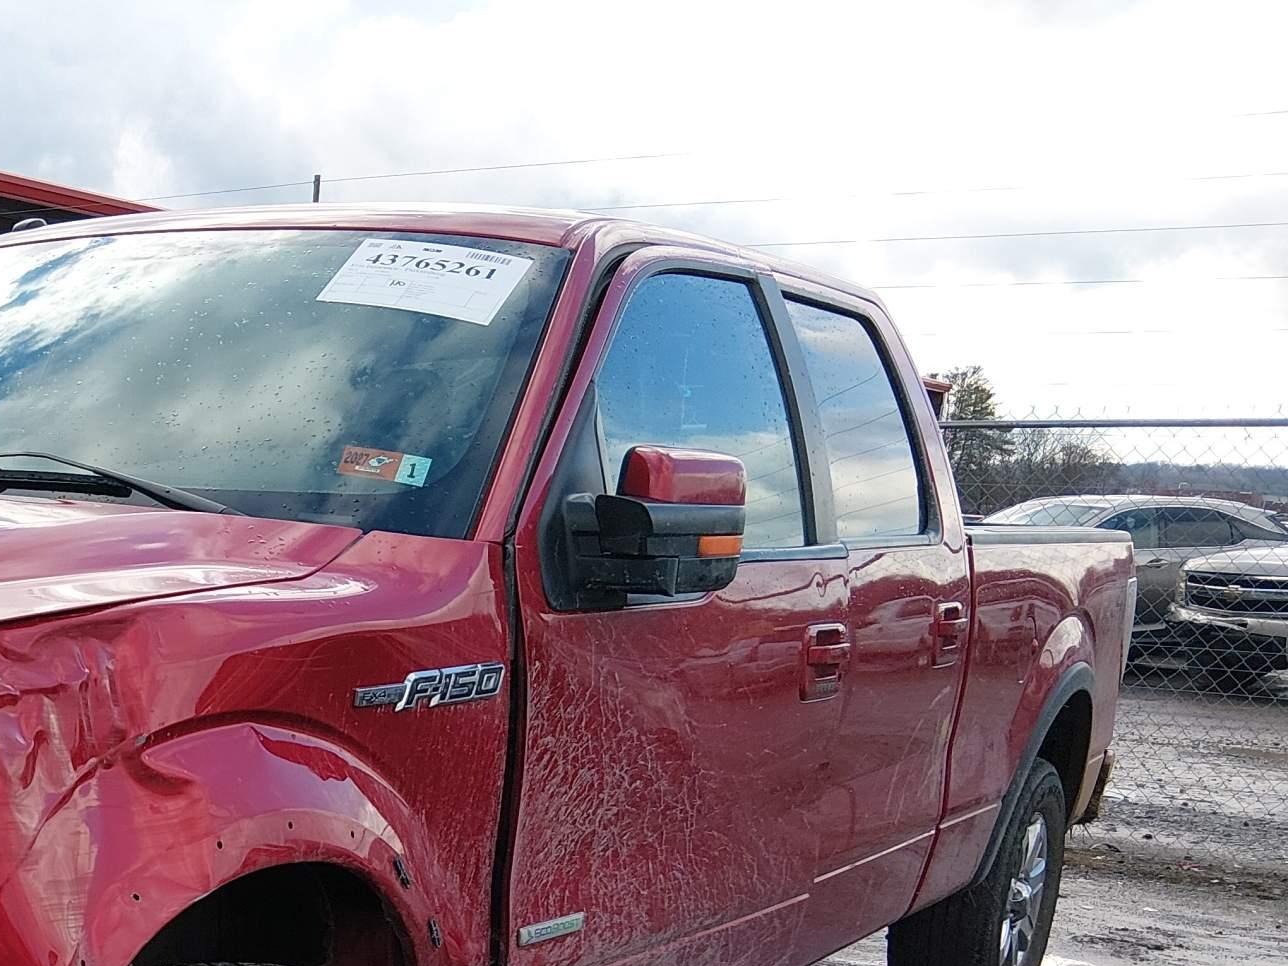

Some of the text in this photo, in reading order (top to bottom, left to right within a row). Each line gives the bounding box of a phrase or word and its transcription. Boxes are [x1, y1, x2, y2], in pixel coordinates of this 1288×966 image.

[366, 253, 497, 280] 43765261
[343, 451, 370, 466] 2027
[407, 463, 417, 478] 1
[362, 690, 388, 702] FX4
